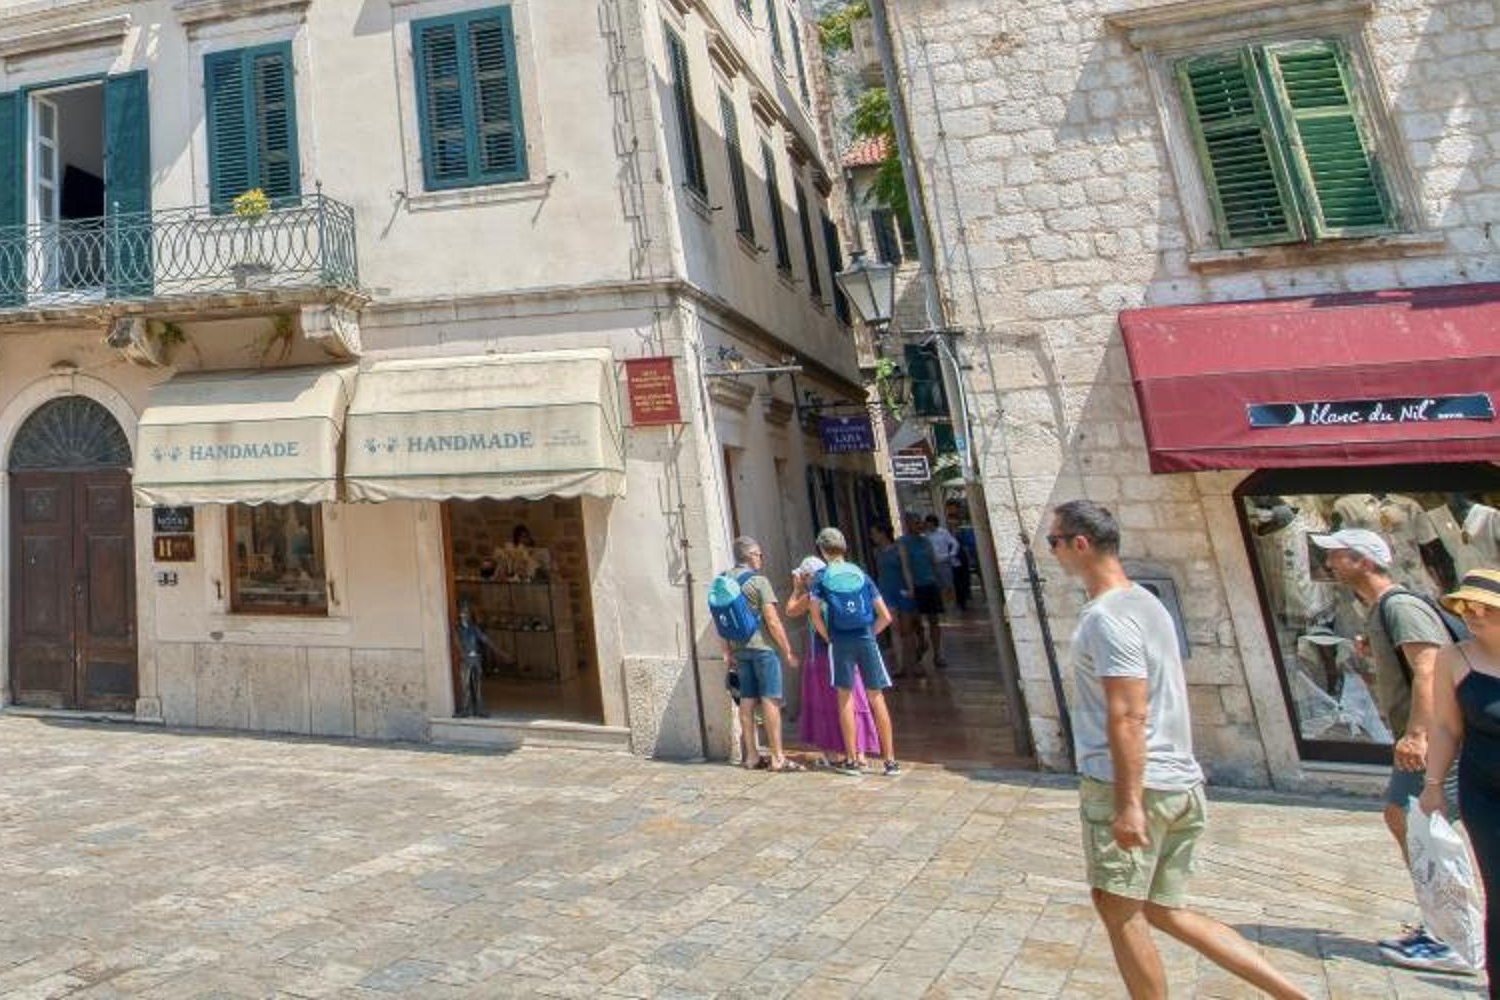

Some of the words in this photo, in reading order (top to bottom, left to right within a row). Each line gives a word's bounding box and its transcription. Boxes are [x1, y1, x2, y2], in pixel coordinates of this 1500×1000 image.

[1310, 403, 1364, 424] blanc
[1368, 402, 1394, 422] du
[1399, 399, 1429, 422] Nil
[190, 441, 300, 461] HANDMADE
[407, 431, 533, 453] HANDMADE
